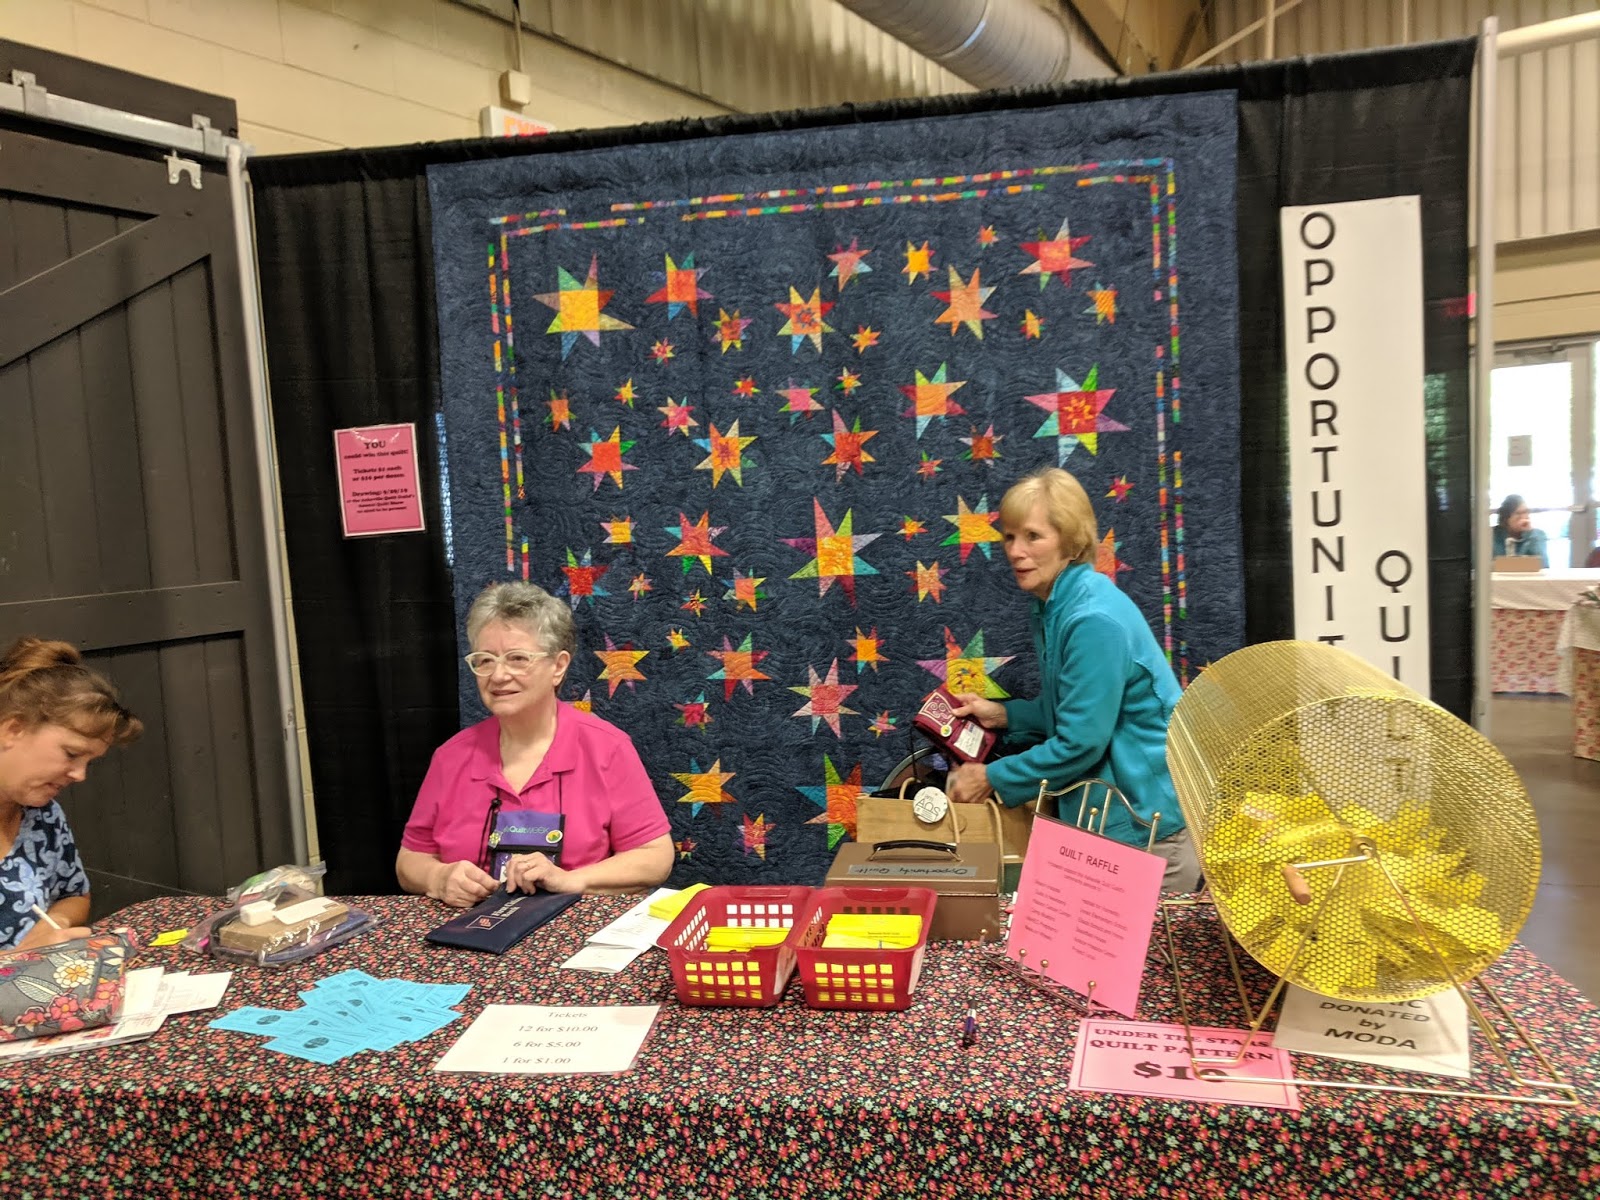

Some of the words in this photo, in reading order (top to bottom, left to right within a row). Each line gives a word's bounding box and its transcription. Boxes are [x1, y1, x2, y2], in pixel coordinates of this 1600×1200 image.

[364, 441, 386, 449] YOU
[1059, 845, 1083, 861] QUILT
[1086, 855, 1120, 875] RAFFLE
[1319, 1002, 1431, 1022] DONATED
[557, 1025, 599, 1033] $10.00
[1359, 1018, 1386, 1030] by
[1094, 1028, 1159, 1040] UNDER
[1164, 1034, 1200, 1043] THE
[1206, 1037, 1271, 1048] STARS
[1324, 1028, 1417, 1050] MODA
[1089, 1039, 1158, 1052] QUILT
[1164, 1045, 1275, 1061] PATTERN
[534, 1057, 572, 1065] $1.00
